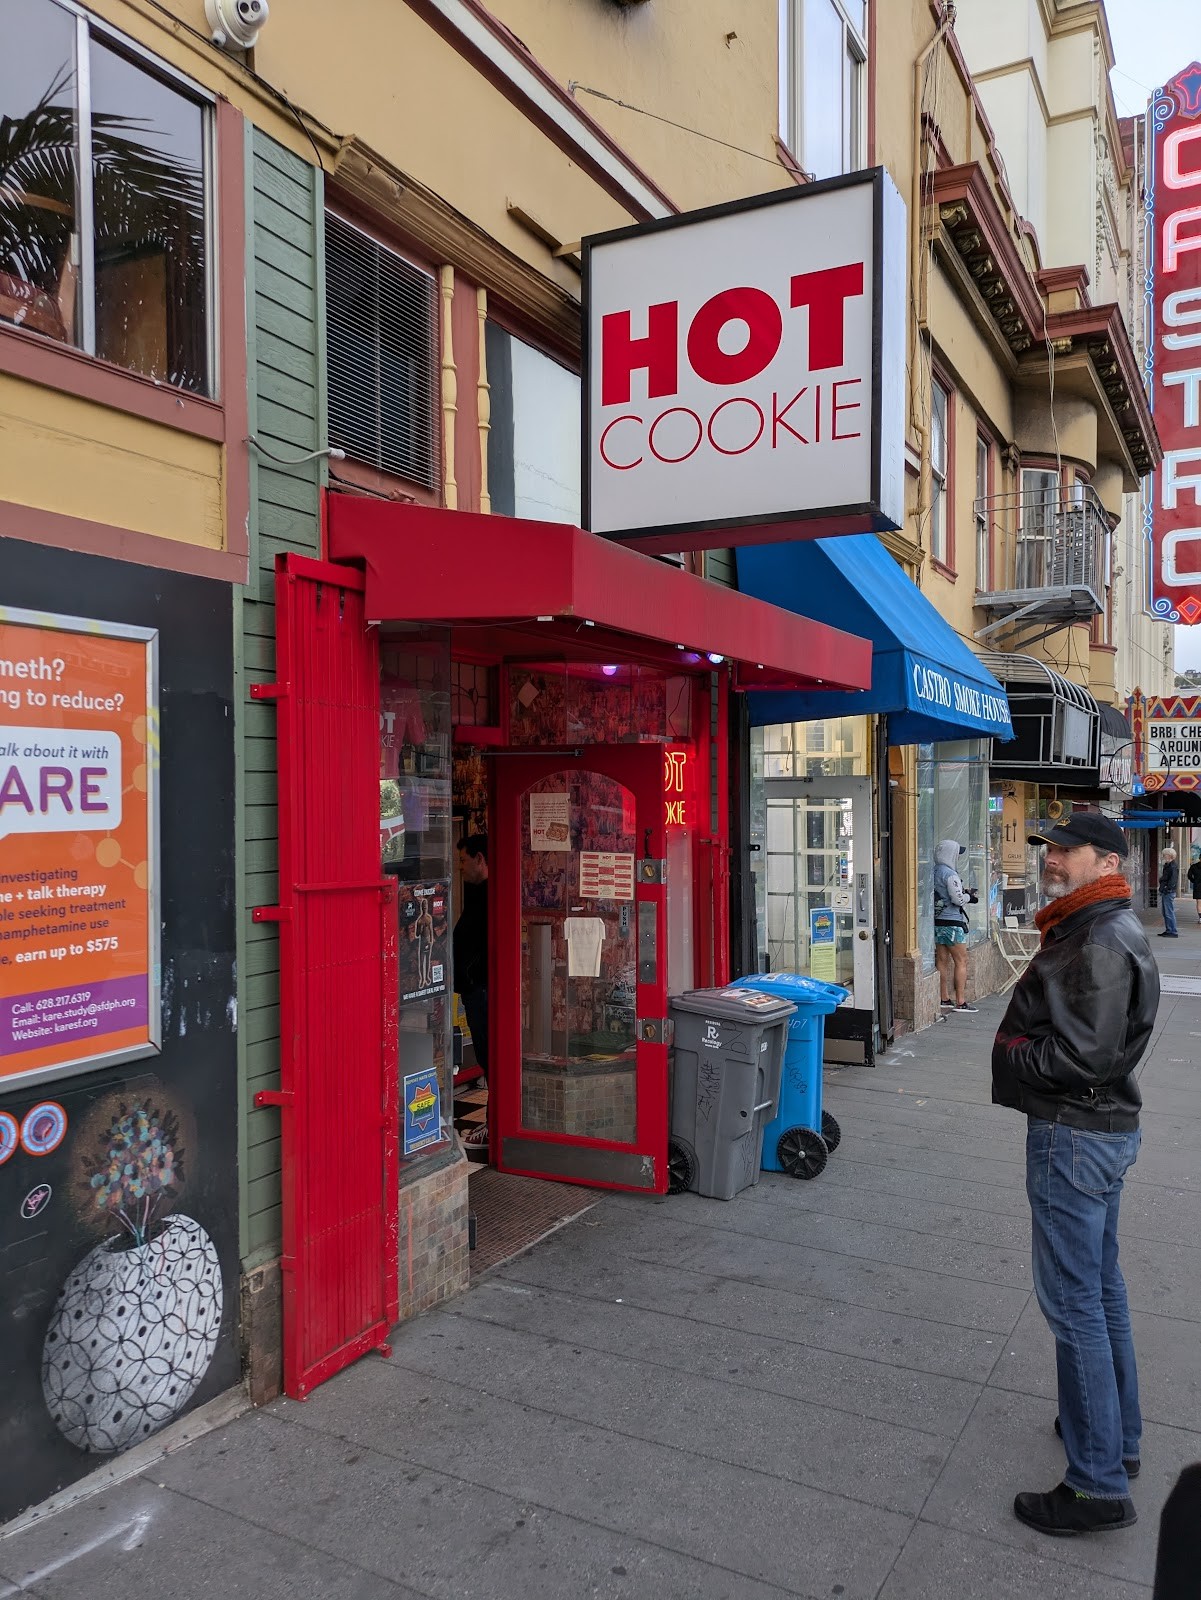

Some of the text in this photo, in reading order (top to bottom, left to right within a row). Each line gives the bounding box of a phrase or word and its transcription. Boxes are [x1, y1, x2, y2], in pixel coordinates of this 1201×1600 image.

[602, 261, 864, 407] HOT
[600, 378, 862, 471] COOKIE
[26, 688, 47, 706] to
[52, 690, 125, 711] reduce?
[913, 663, 1011, 724] CASTRO SMOKE HOUSE
[1150, 726, 1176, 738] BRB!
[23, 743, 65, 758] about
[68, 745, 78, 759] it
[81, 746, 109, 759] with
[1159, 740, 1201, 752] AROUN
[16, 892, 24, 900] +
[27, 886, 54, 899] talk
[56, 884, 107, 897] therapy
[18, 904, 66, 919] seeking
[70, 899, 126, 914] treatment
[90, 919, 109, 929] use
[15, 948, 47, 963] earn
[50, 946, 67, 960] up
[70, 944, 83, 955] to
[86, 936, 119, 953] $575
[12, 991, 91, 1015] Call: 628.217.6319
[12, 997, 136, 1028] Email: kare.study@sfdph.org
[12, 1017, 98, 1041] Website: karesf.org
[416, 1100, 431, 1109] SAFE
